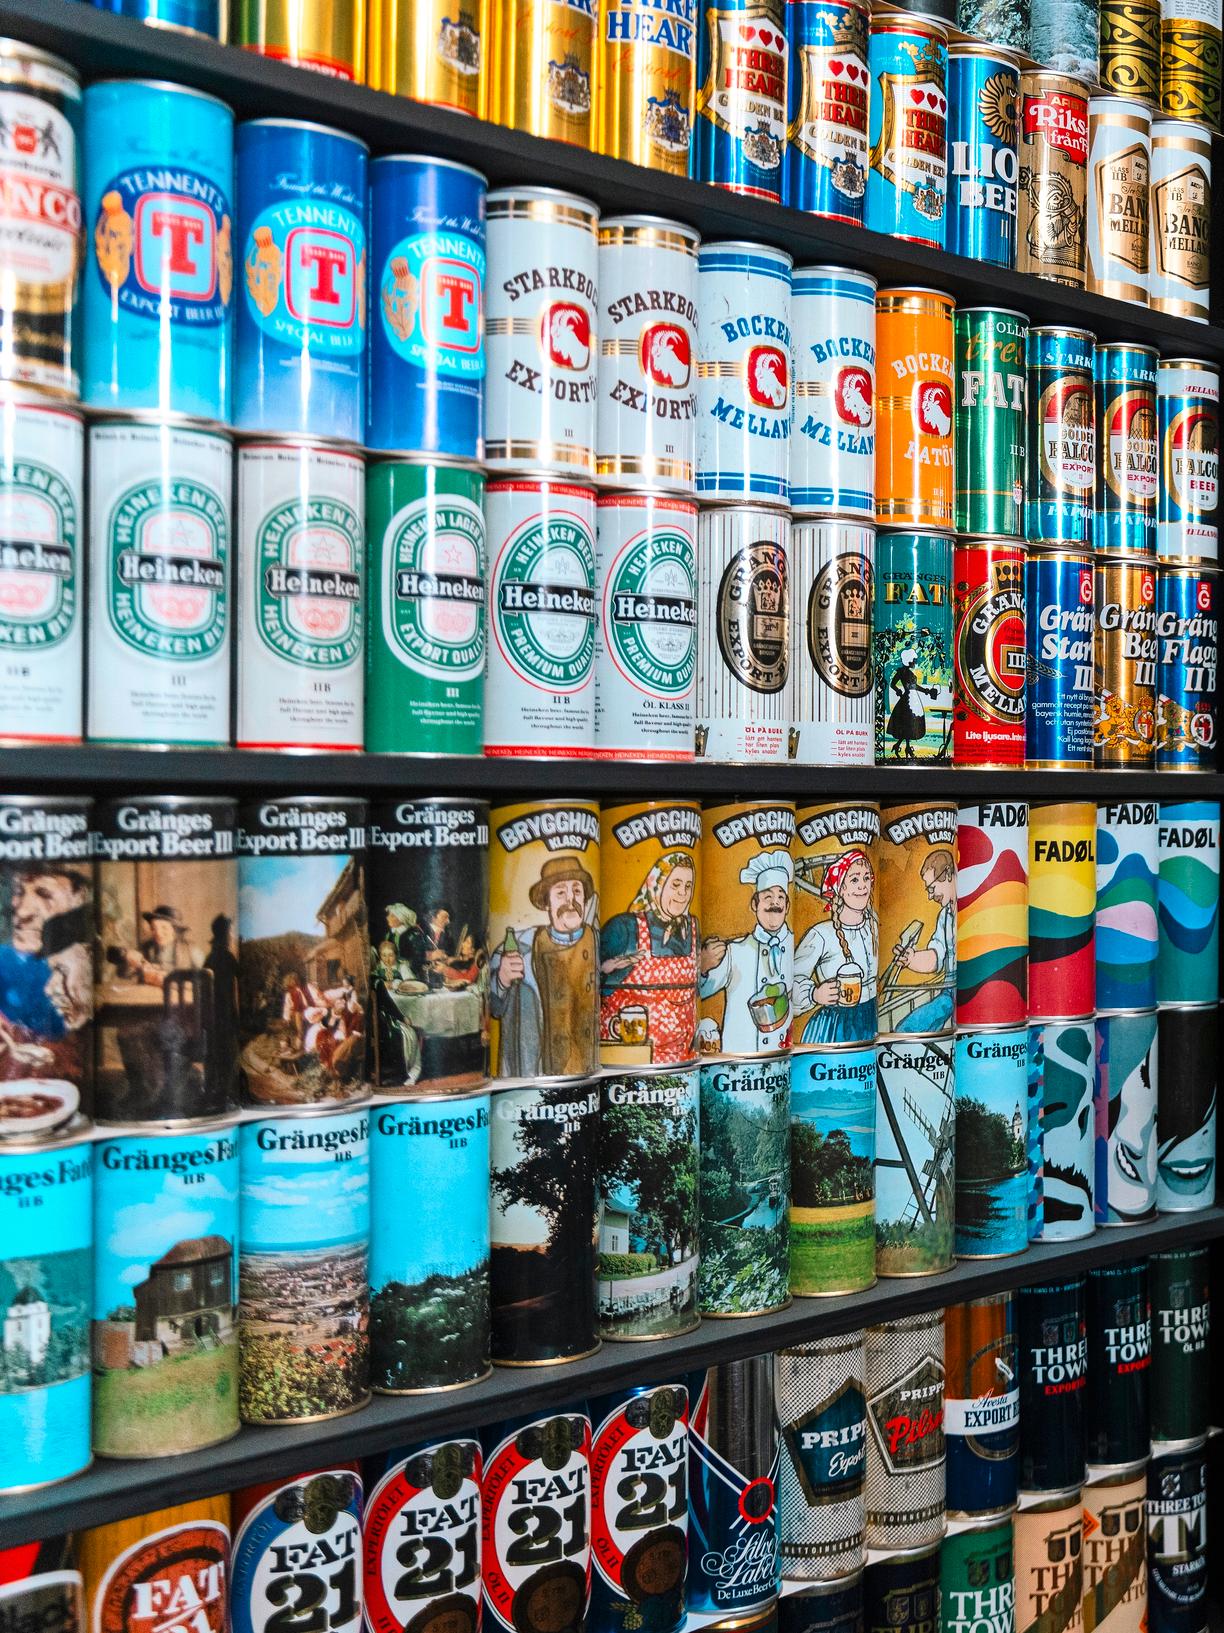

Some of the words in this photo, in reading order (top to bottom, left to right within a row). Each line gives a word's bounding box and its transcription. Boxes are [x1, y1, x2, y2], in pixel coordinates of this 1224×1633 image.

[962, 371, 1024, 411] FAT
[1190, 480, 1215, 491] BEER
[117, 485, 202, 542] HEINEKEN
[265, 505, 344, 557] HEINEKEN
[517, 529, 574, 564] HEINEKEN
[629, 541, 683, 576] HEINEKEN
[124, 556, 224, 587] Heineken
[271, 569, 360, 597] Heineken
[885, 583, 945, 604] FAT
[117, 593, 201, 655] HEINEKEN
[265, 605, 340, 664] HEINEKEN
[400, 623, 448, 664] EXPORT
[510, 629, 565, 678] PREMIUM
[623, 637, 673, 683] PREMIUM
[643, 700, 657, 711] ÖL
[660, 701, 684, 711] KLASS
[966, 731, 981, 740] Lite
[3, 807, 87, 836] Gränges
[118, 807, 212, 836] Gränges
[260, 804, 346, 832] Gränges
[396, 804, 475, 830] Gränges
[1106, 804, 1158, 825] FADØL
[163, 832, 212, 853] Beer
[216, 832, 232, 852] III
[300, 829, 347, 849] Beer
[350, 829, 364, 847] III
[372, 829, 432, 850] Export
[435, 827, 477, 845] Beer
[549, 832, 581, 847] KLASS
[663, 831, 691, 846] KLASS
[761, 832, 786, 845] KLASS
[841, 830, 866, 843] KLASS
[928, 830, 950, 842] KLASS
[1158, 828, 1215, 848] FADØL
[1035, 841, 1094, 862] FADØL
[967, 1043, 1026, 1059] Gränges
[712, 1067, 787, 1093] Gränges
[810, 1062, 875, 1080] Gränges
[378, 1114, 474, 1139] Gränges
[257, 1129, 358, 1152] Gränges
[102, 1146, 213, 1173] Gränges
[964, 1405, 1011, 1428] EXPORT
[620, 1438, 686, 1472] FAT
[512, 1466, 587, 1504] FAT
[615, 1463, 687, 1532] 21
[401, 1494, 479, 1535] FAT
[506, 1499, 586, 1566] 21
[270, 1528, 358, 1572] FAT
[395, 1525, 480, 1600] 21
[134, 1562, 226, 1619] FAT
[718, 1590, 730, 1600] De
[732, 1587, 752, 1598] Luxe
[754, 1584, 768, 1596] Beer
